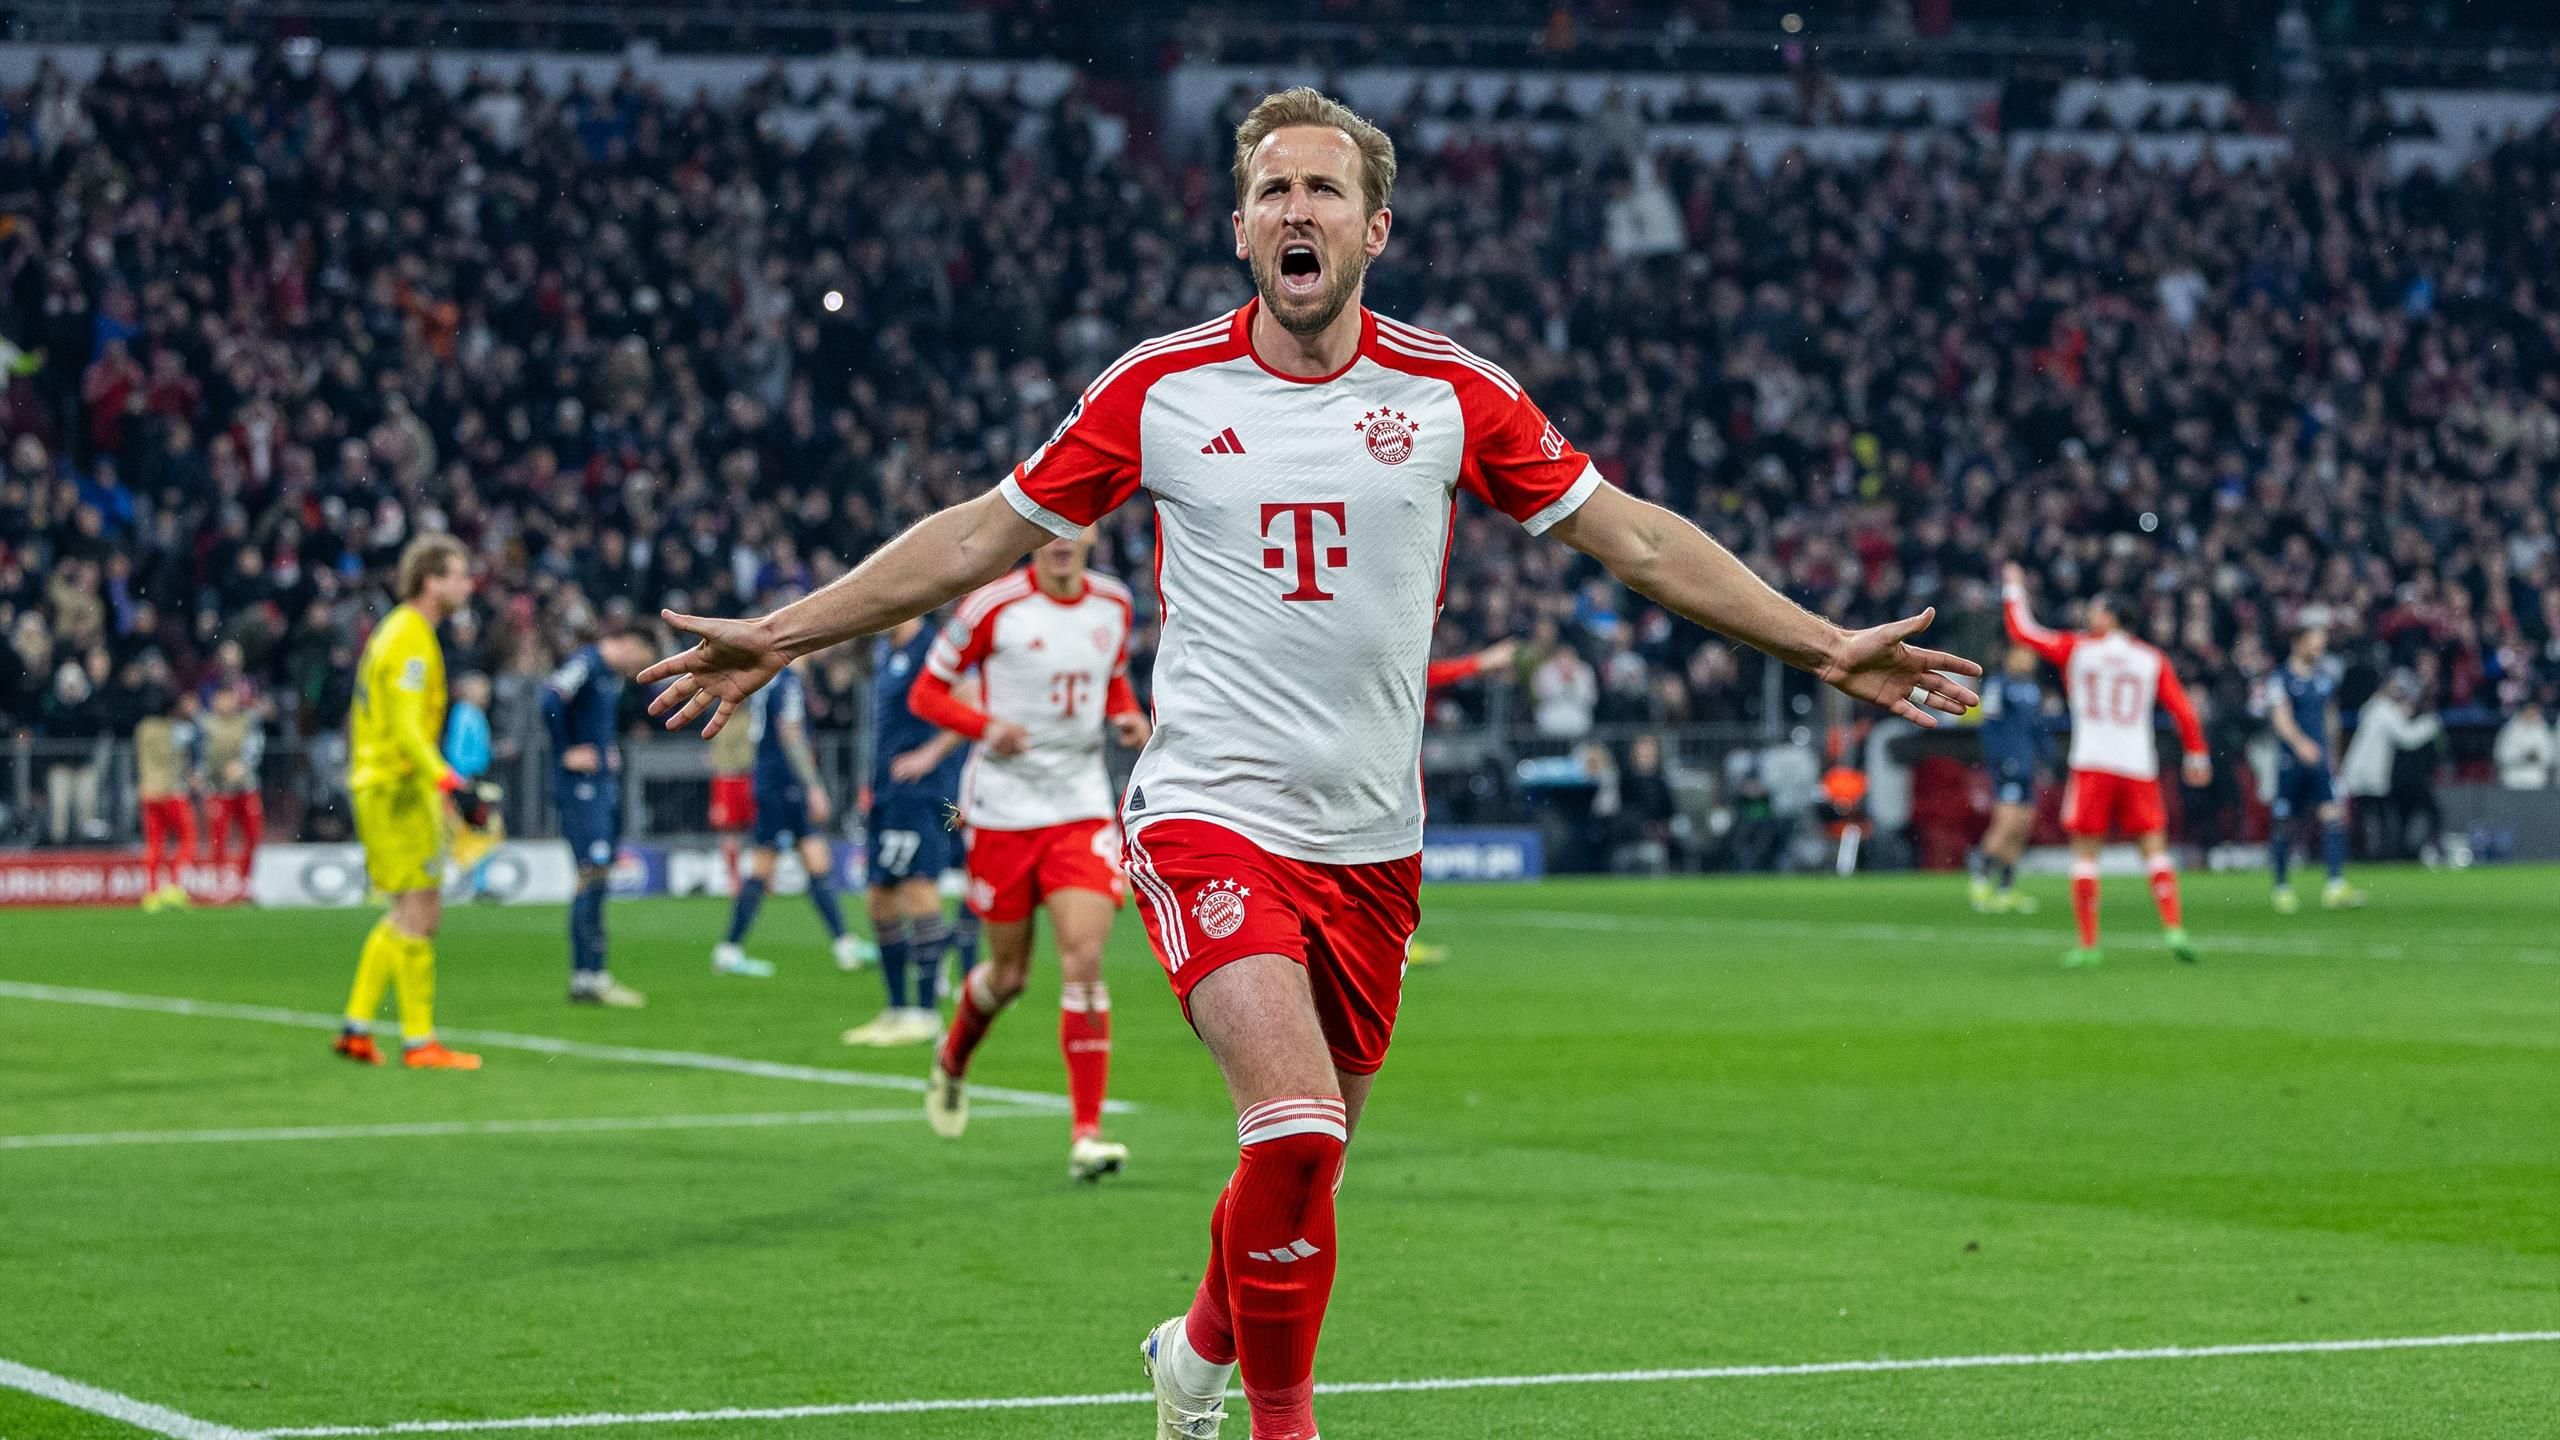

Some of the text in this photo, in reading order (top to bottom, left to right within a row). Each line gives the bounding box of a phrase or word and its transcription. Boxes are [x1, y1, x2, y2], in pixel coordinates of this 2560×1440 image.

[1370, 422, 1409, 439] FC BAYERN
[1261, 502, 1347, 601] T
[2082, 671, 2144, 726] 10
[878, 829, 921, 877] 77
[1207, 895, 1239, 908] BAYERN
